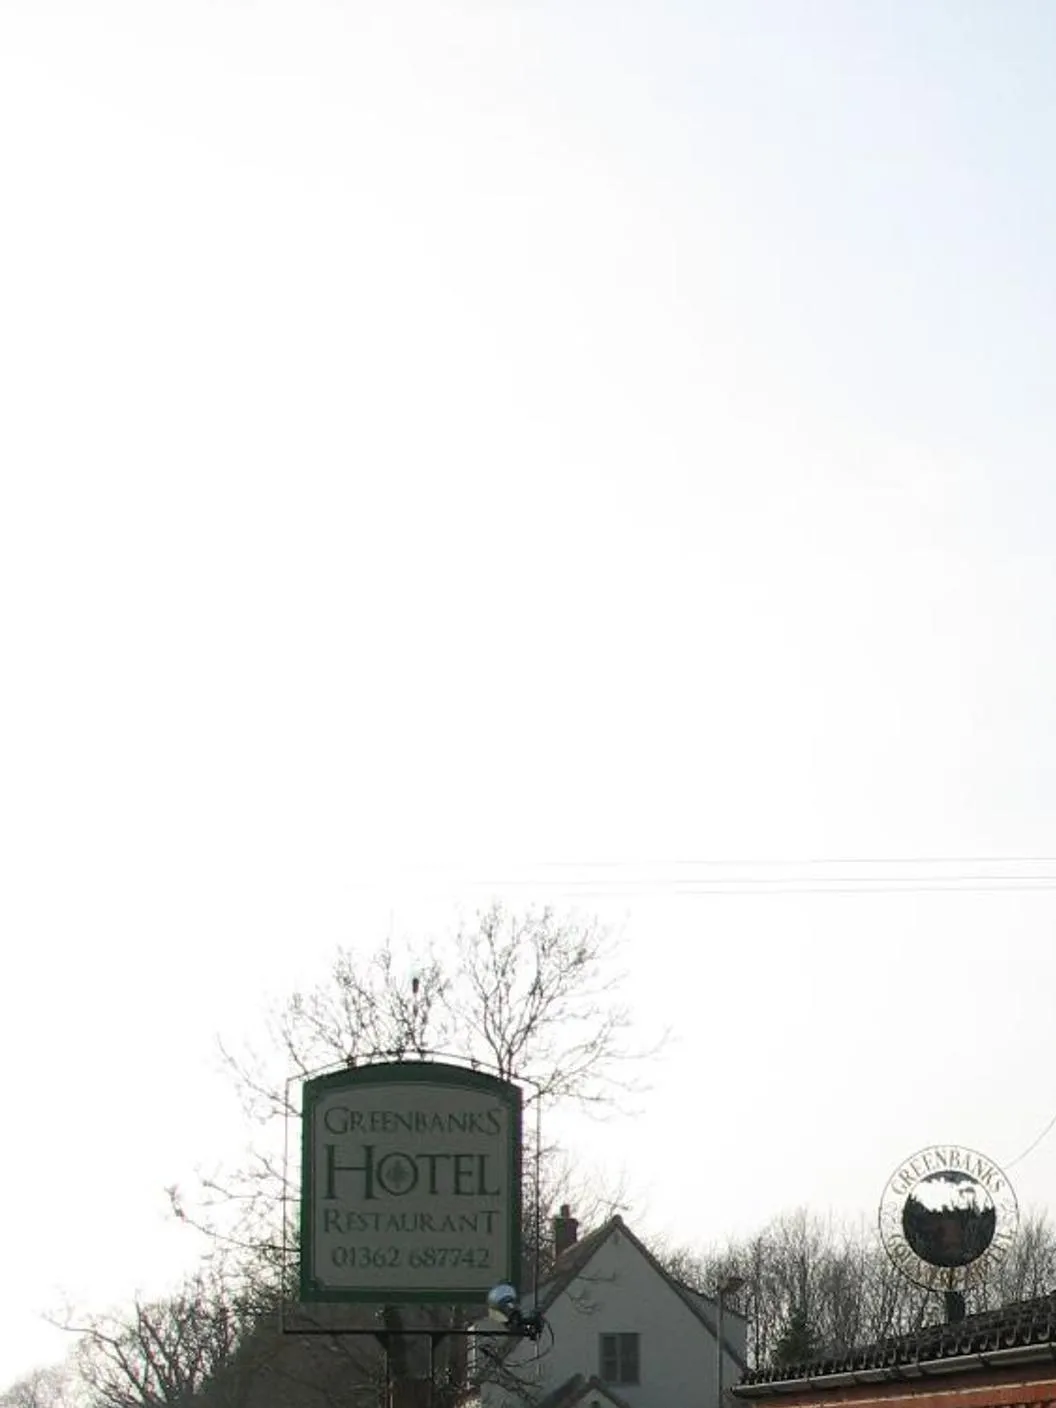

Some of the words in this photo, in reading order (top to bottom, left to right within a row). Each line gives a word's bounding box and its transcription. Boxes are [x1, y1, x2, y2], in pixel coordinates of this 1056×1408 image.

[324, 1105, 501, 1136] GREENBANKS
[323, 1143, 501, 1200] HOTEL
[891, 1149, 1005, 1196] GREENBANKS
[323, 1208, 500, 1236] RESTAURANT
[331, 1245, 400, 1269] 01362
[408, 1245, 491, 1270] 687742
